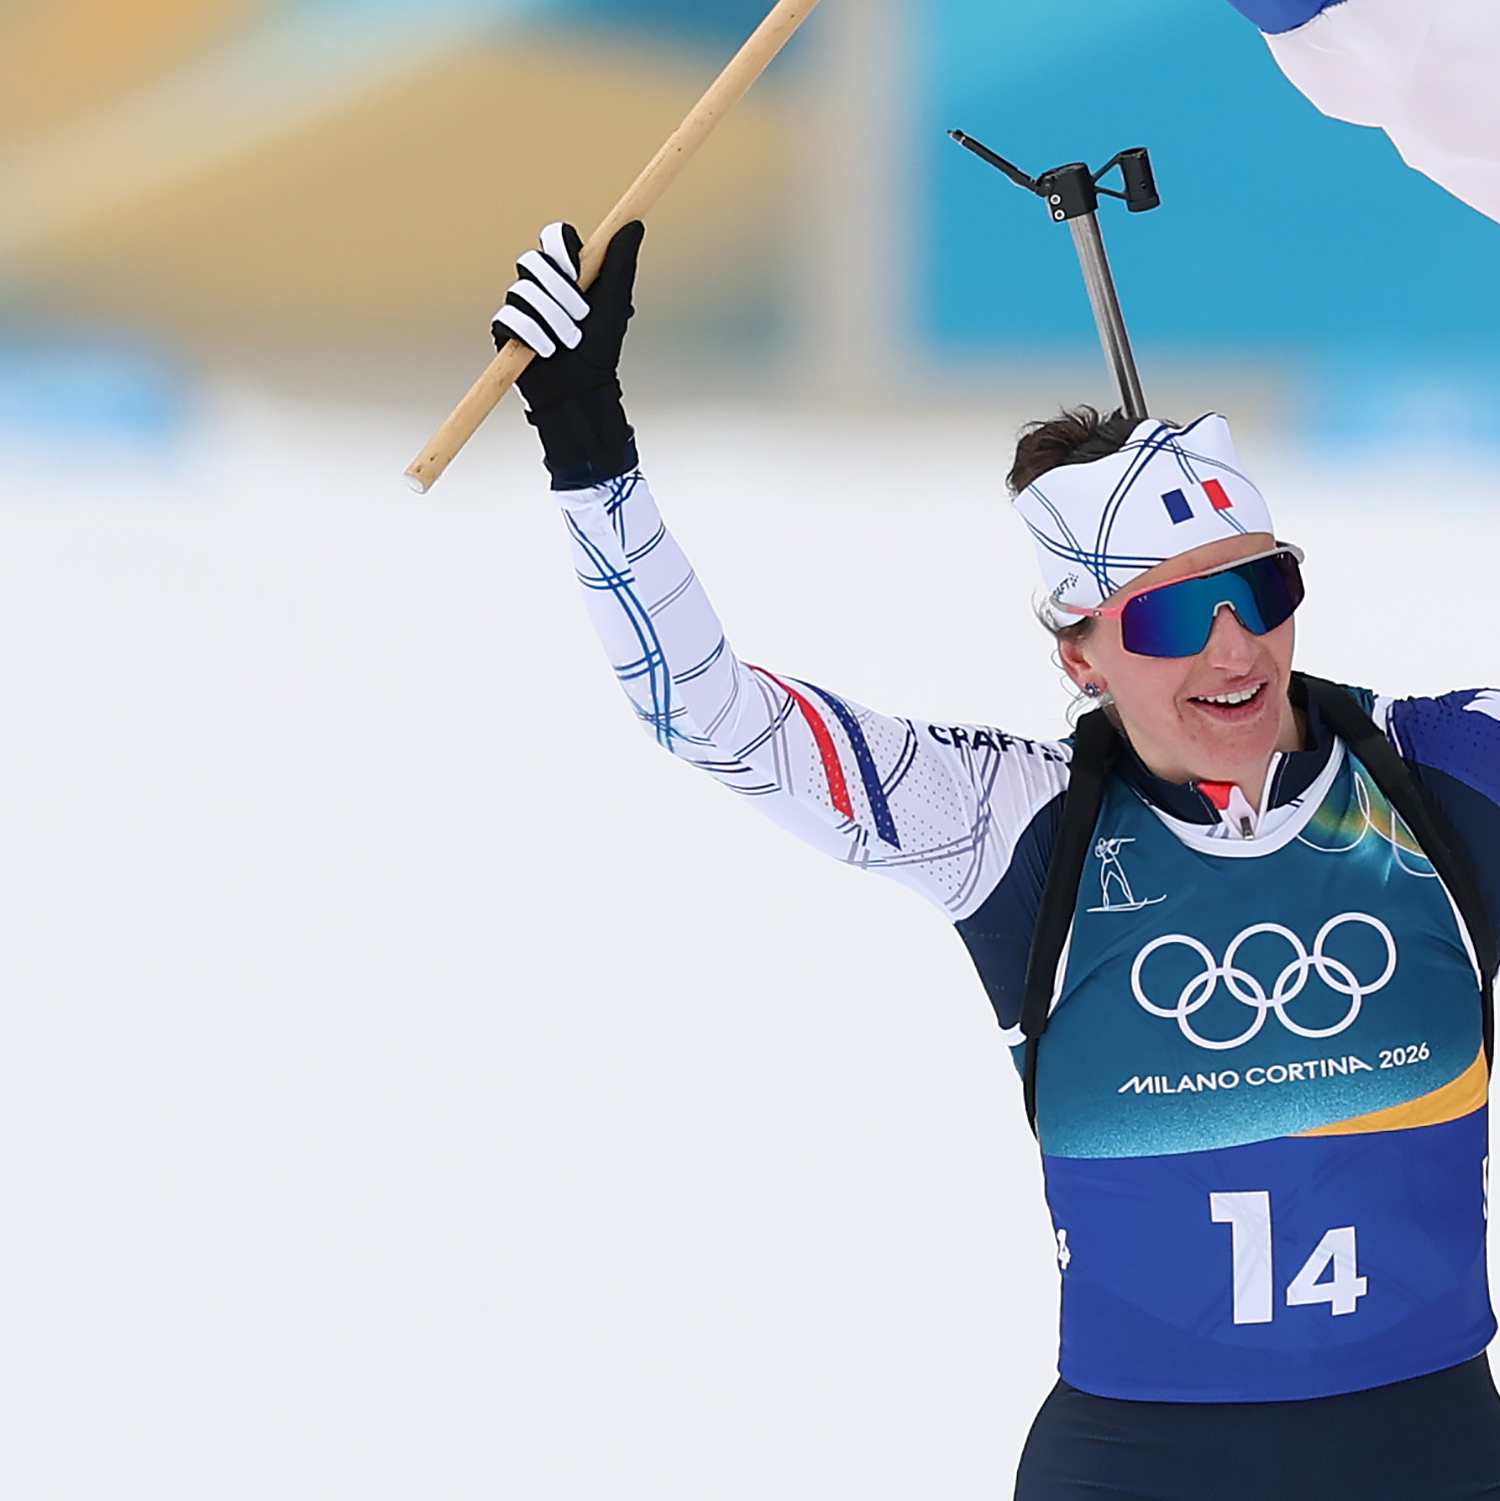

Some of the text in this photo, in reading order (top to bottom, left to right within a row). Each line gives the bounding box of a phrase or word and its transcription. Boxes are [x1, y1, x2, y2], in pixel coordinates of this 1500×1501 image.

[928, 724, 1035, 755] CRAFT
[1118, 1042, 1431, 1094] MILANO CORTINA 2026
